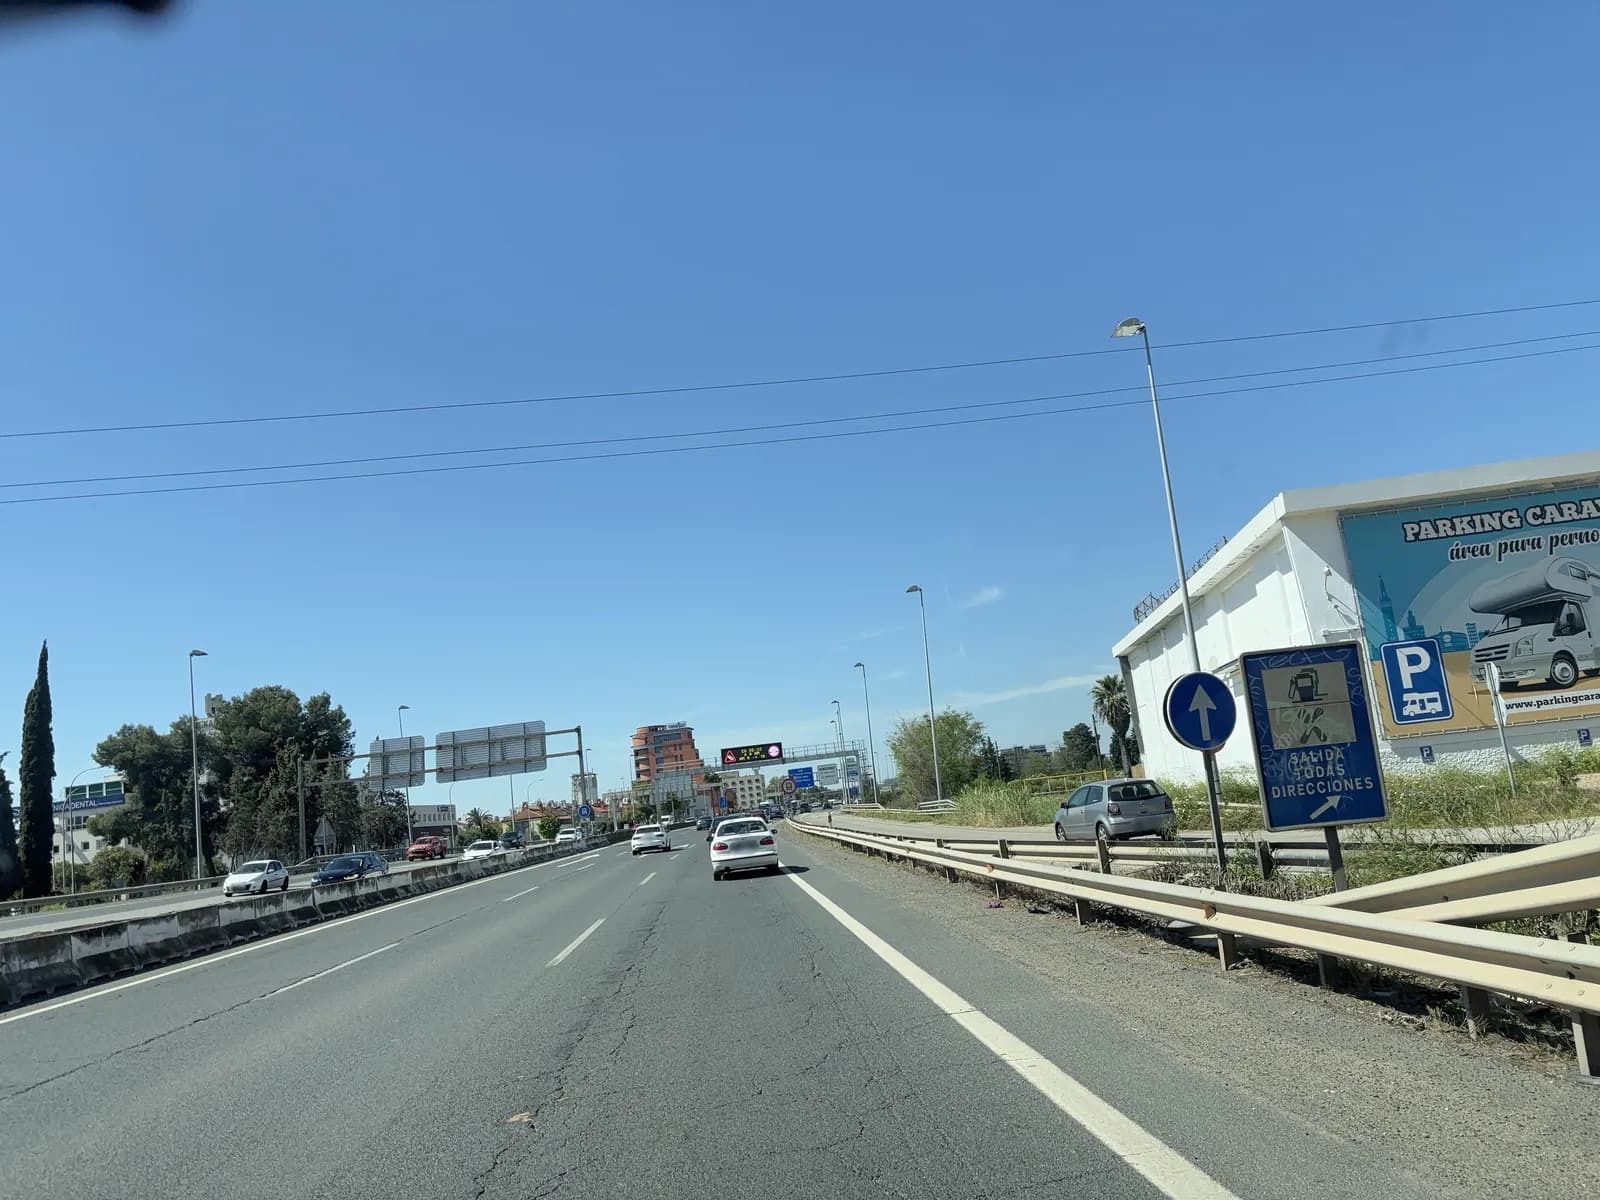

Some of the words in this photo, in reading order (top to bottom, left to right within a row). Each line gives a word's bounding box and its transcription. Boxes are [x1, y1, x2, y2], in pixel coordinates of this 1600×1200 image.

[1403, 509, 1522, 542] PARKING
[1449, 540, 1492, 561] área
[1499, 535, 1542, 562] para
[1550, 528, 1600, 555] perno
[1396, 646, 1431, 689] P
[1289, 748, 1345, 765] SALIDA
[1294, 764, 1345, 781] TODAS
[1271, 776, 1374, 799] DIRECCIONES
[71, 799, 98, 810] DENTAL
